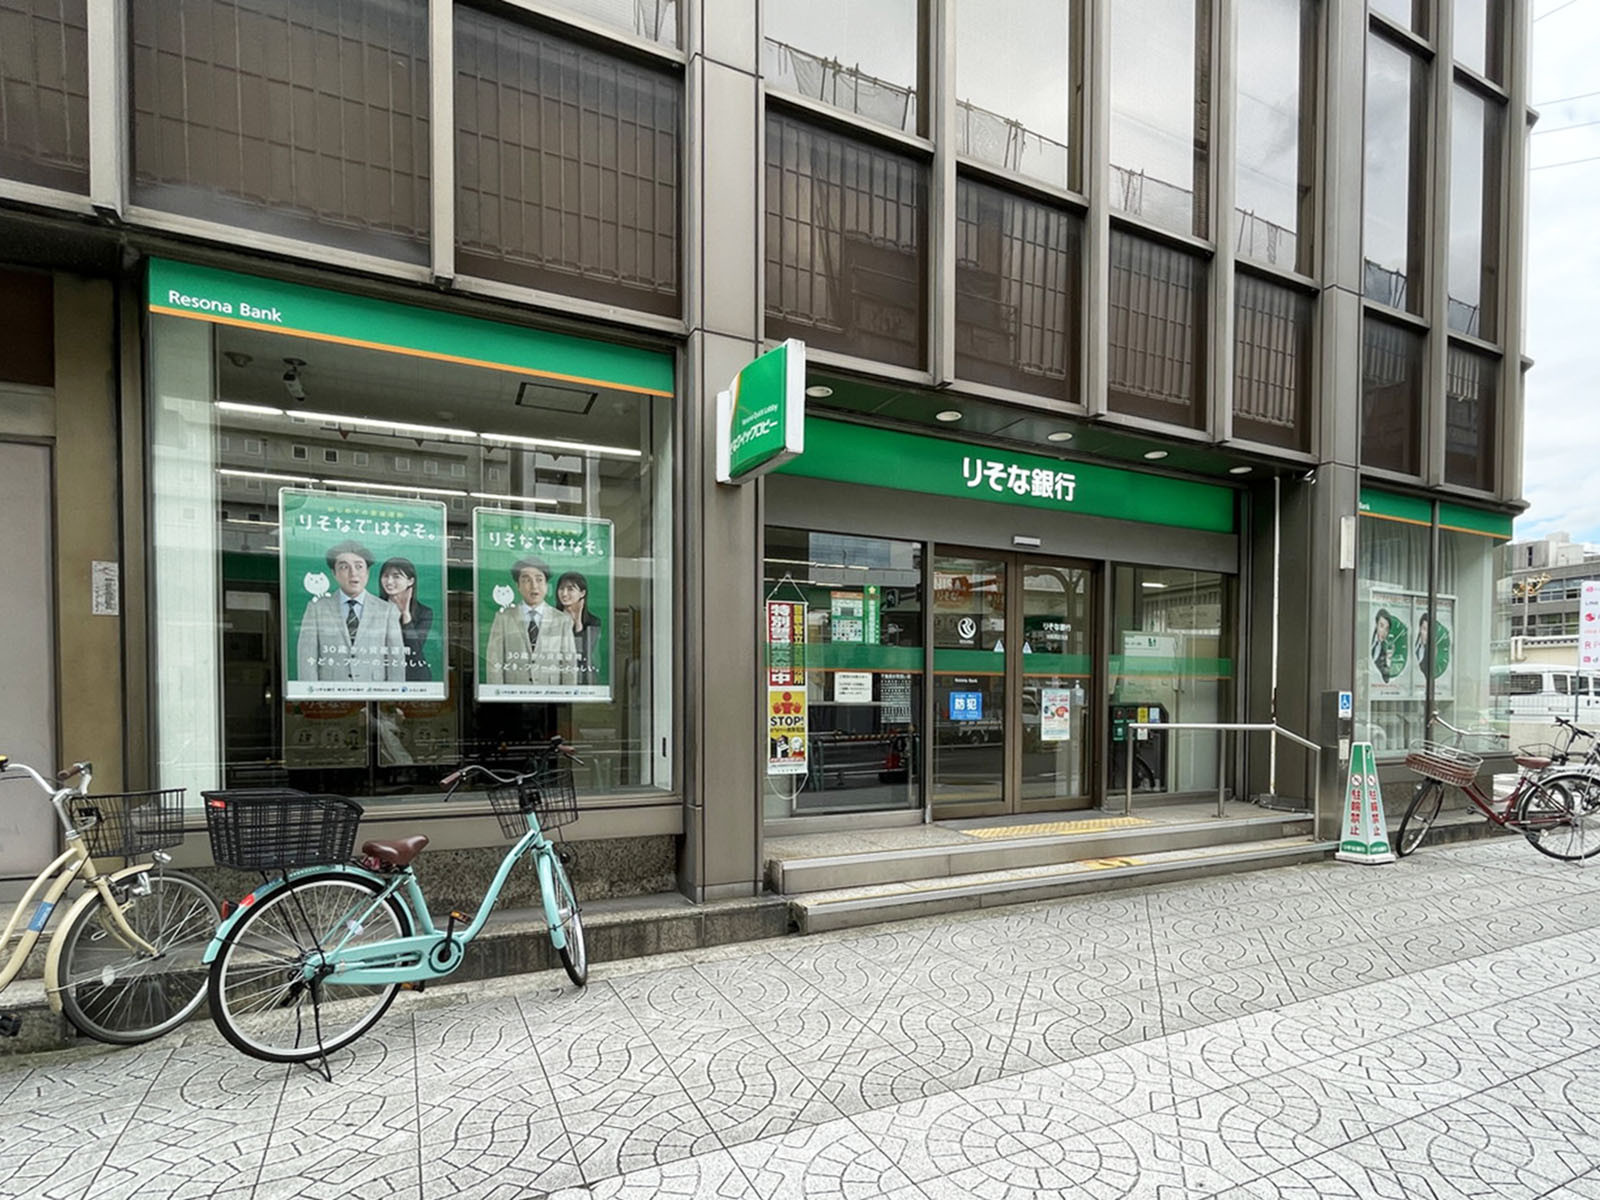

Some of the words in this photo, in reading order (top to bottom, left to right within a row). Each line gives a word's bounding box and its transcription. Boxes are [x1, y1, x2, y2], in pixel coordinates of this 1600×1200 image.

[168, 289, 232, 314] Resona
[240, 302, 282, 322] Bank
[963, 457, 1076, 501] りそな銀行
[954, 698, 977, 710] 防犯
